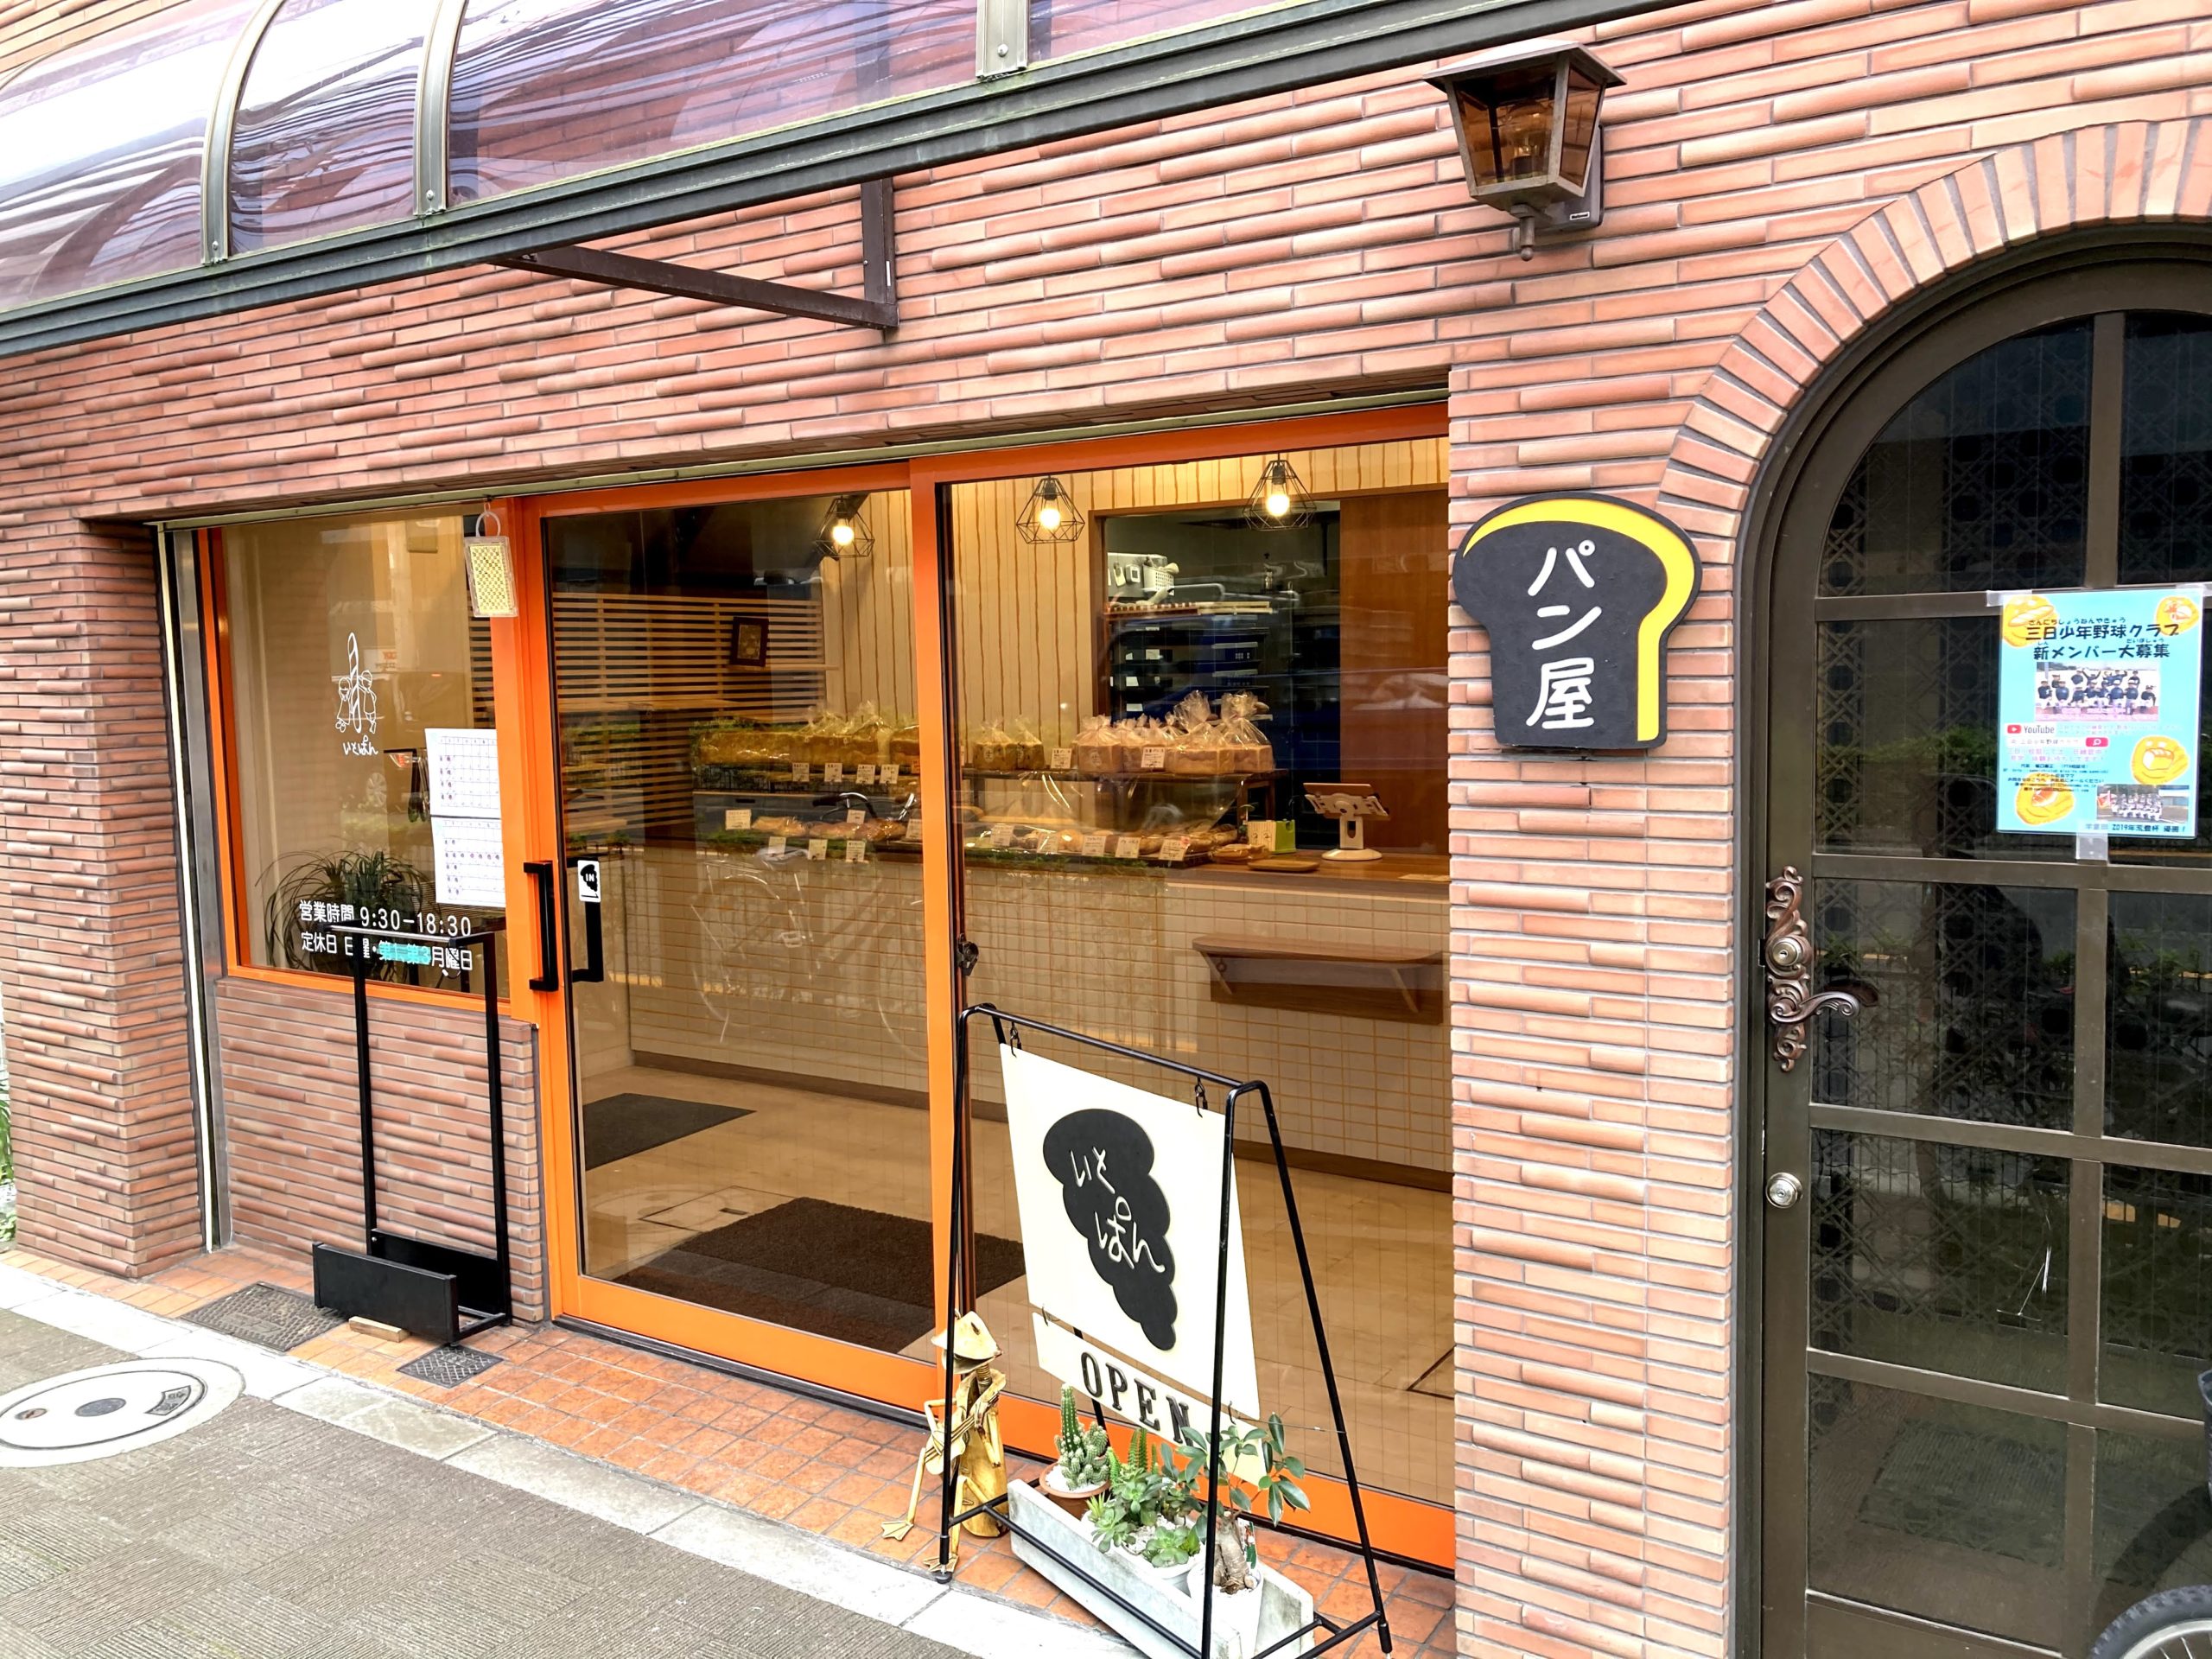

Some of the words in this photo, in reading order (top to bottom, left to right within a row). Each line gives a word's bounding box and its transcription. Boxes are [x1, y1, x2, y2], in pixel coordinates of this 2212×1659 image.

[1525, 539, 1603, 729] パン屋
[2033, 644, 2171, 660] 新メンバー大募集
[2024, 725, 2055, 734] YouTube
[342, 734, 379, 756] いとぱん
[585, 873, 595, 882] IN
[299, 899, 355, 923] 営業時間
[301, 931, 338, 955] 定休日
[1080, 1351, 1194, 1447] OPEN
